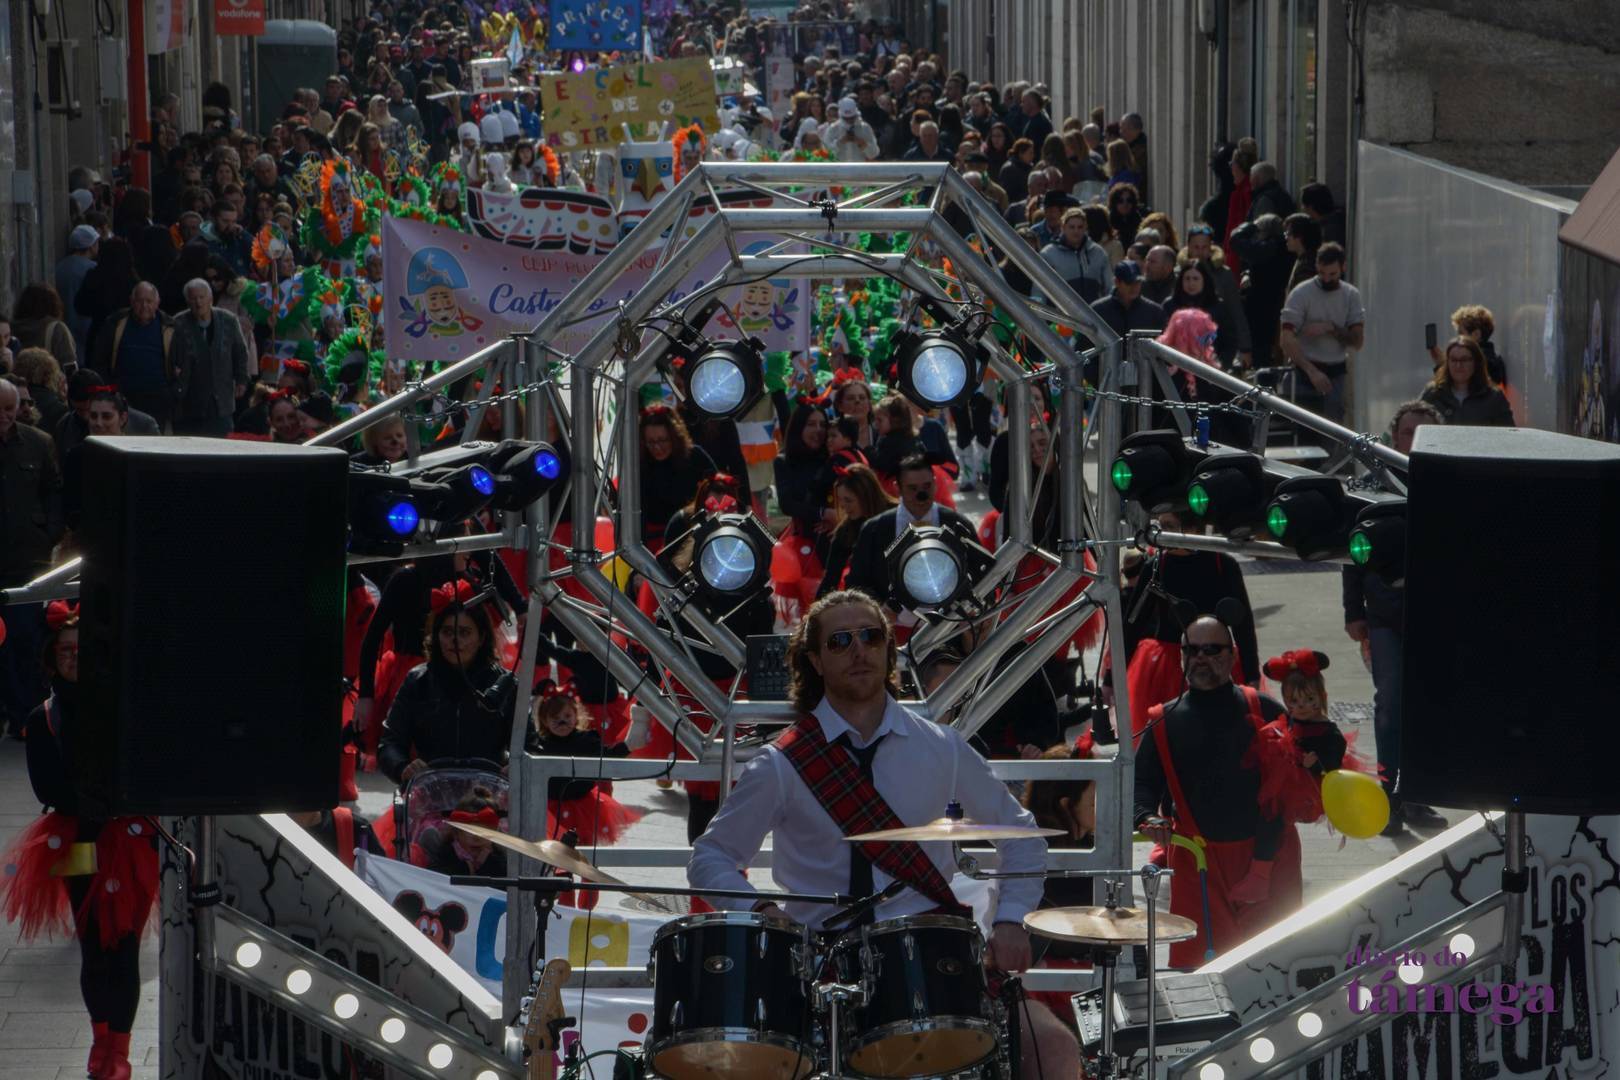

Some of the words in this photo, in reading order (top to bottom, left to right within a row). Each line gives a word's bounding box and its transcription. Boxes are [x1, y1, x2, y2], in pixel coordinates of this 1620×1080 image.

[217, 9, 261, 18] vodafone
[555, 2, 637, 46] PRINCESA
[1531, 866, 1586, 929] LOS
